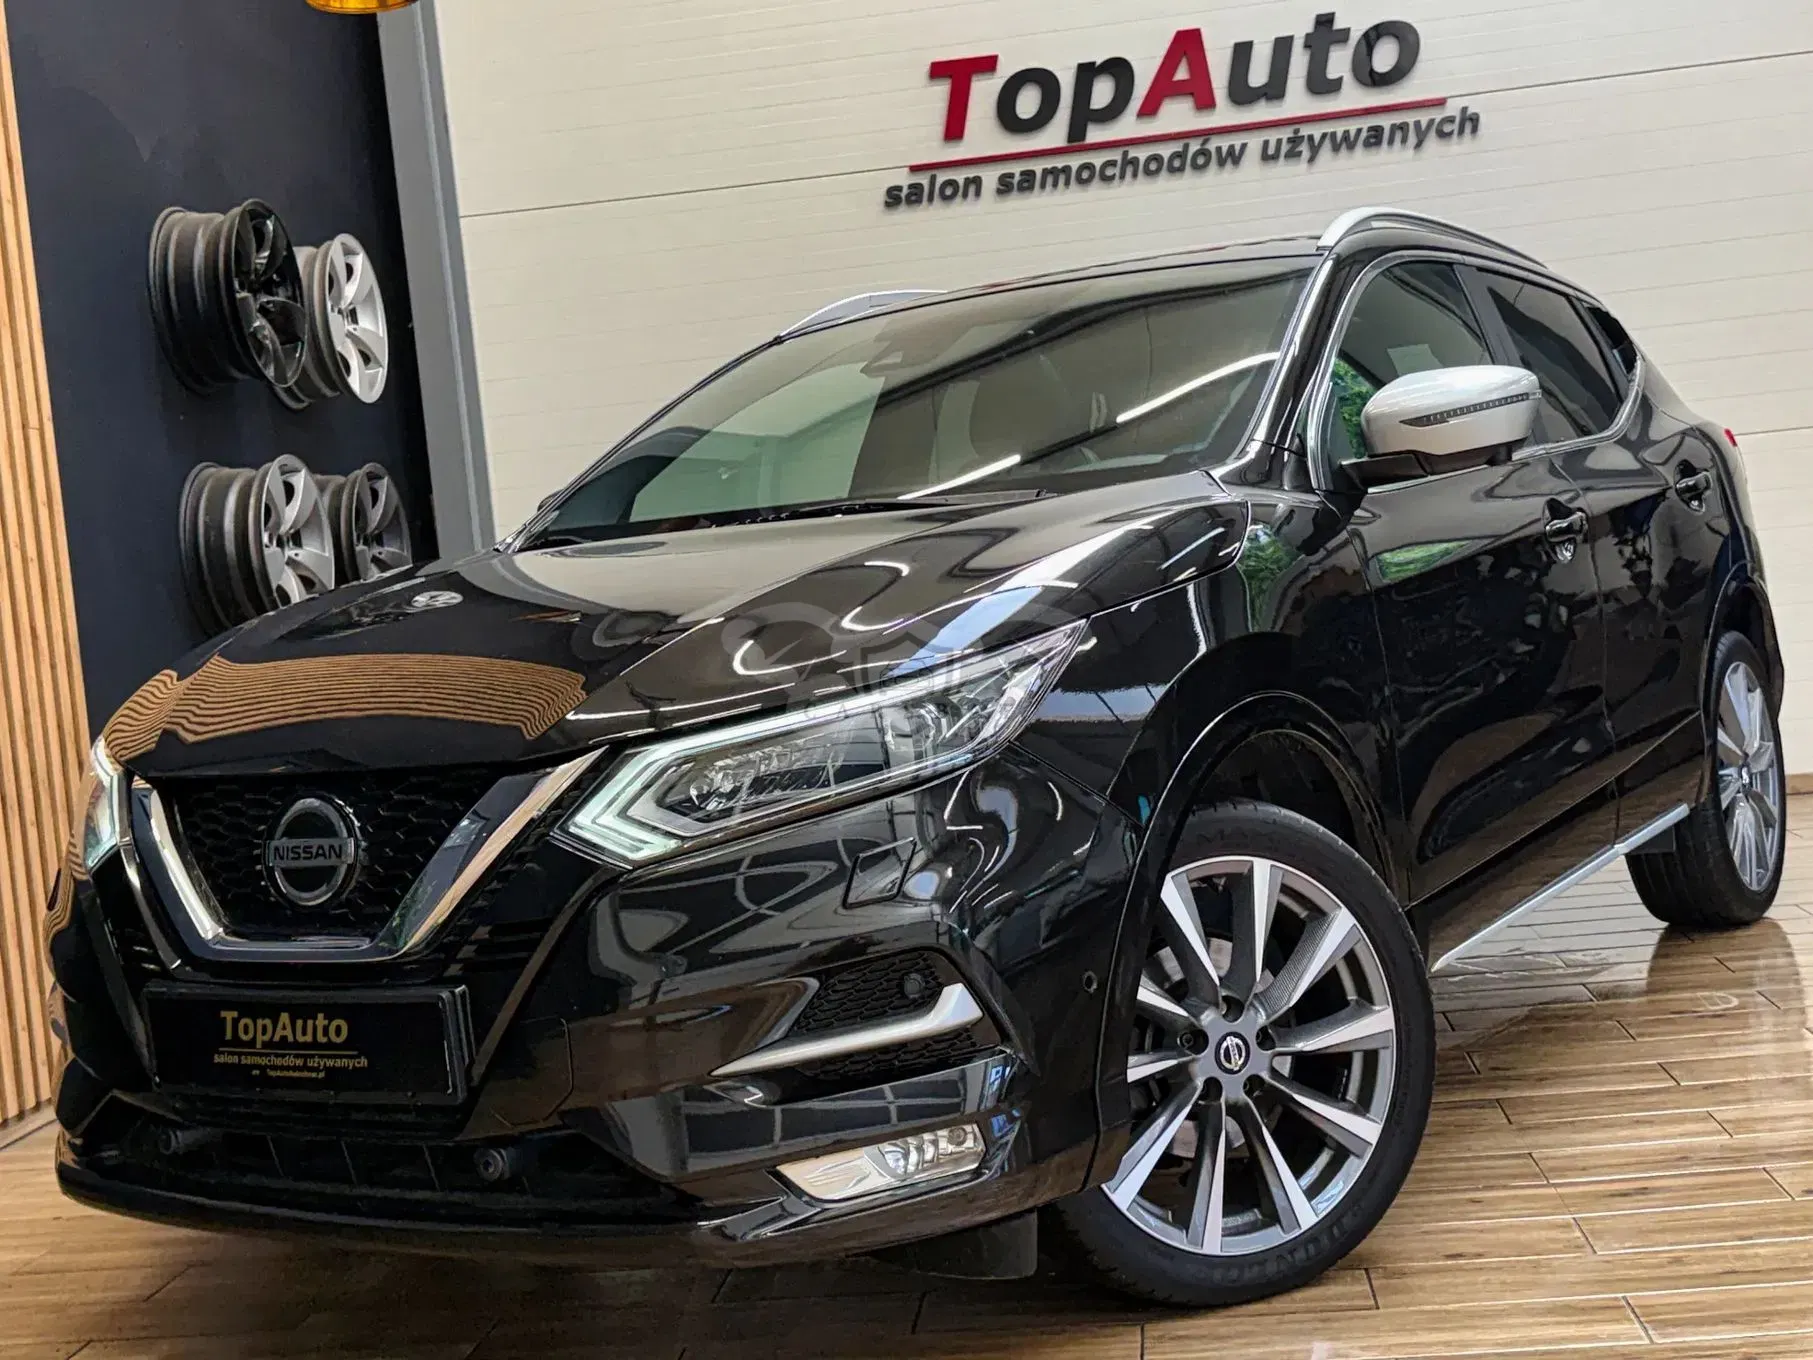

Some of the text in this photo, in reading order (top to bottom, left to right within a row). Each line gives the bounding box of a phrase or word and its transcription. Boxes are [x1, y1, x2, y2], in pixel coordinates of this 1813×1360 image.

[929, 12, 1420, 143] TopAuto
[884, 106, 1480, 209] salon samochodów używanych
[273, 844, 342, 860] NISSAN
[220, 1010, 348, 1048] TopAuto
[214, 1052, 368, 1070] salon samochodów używanych
